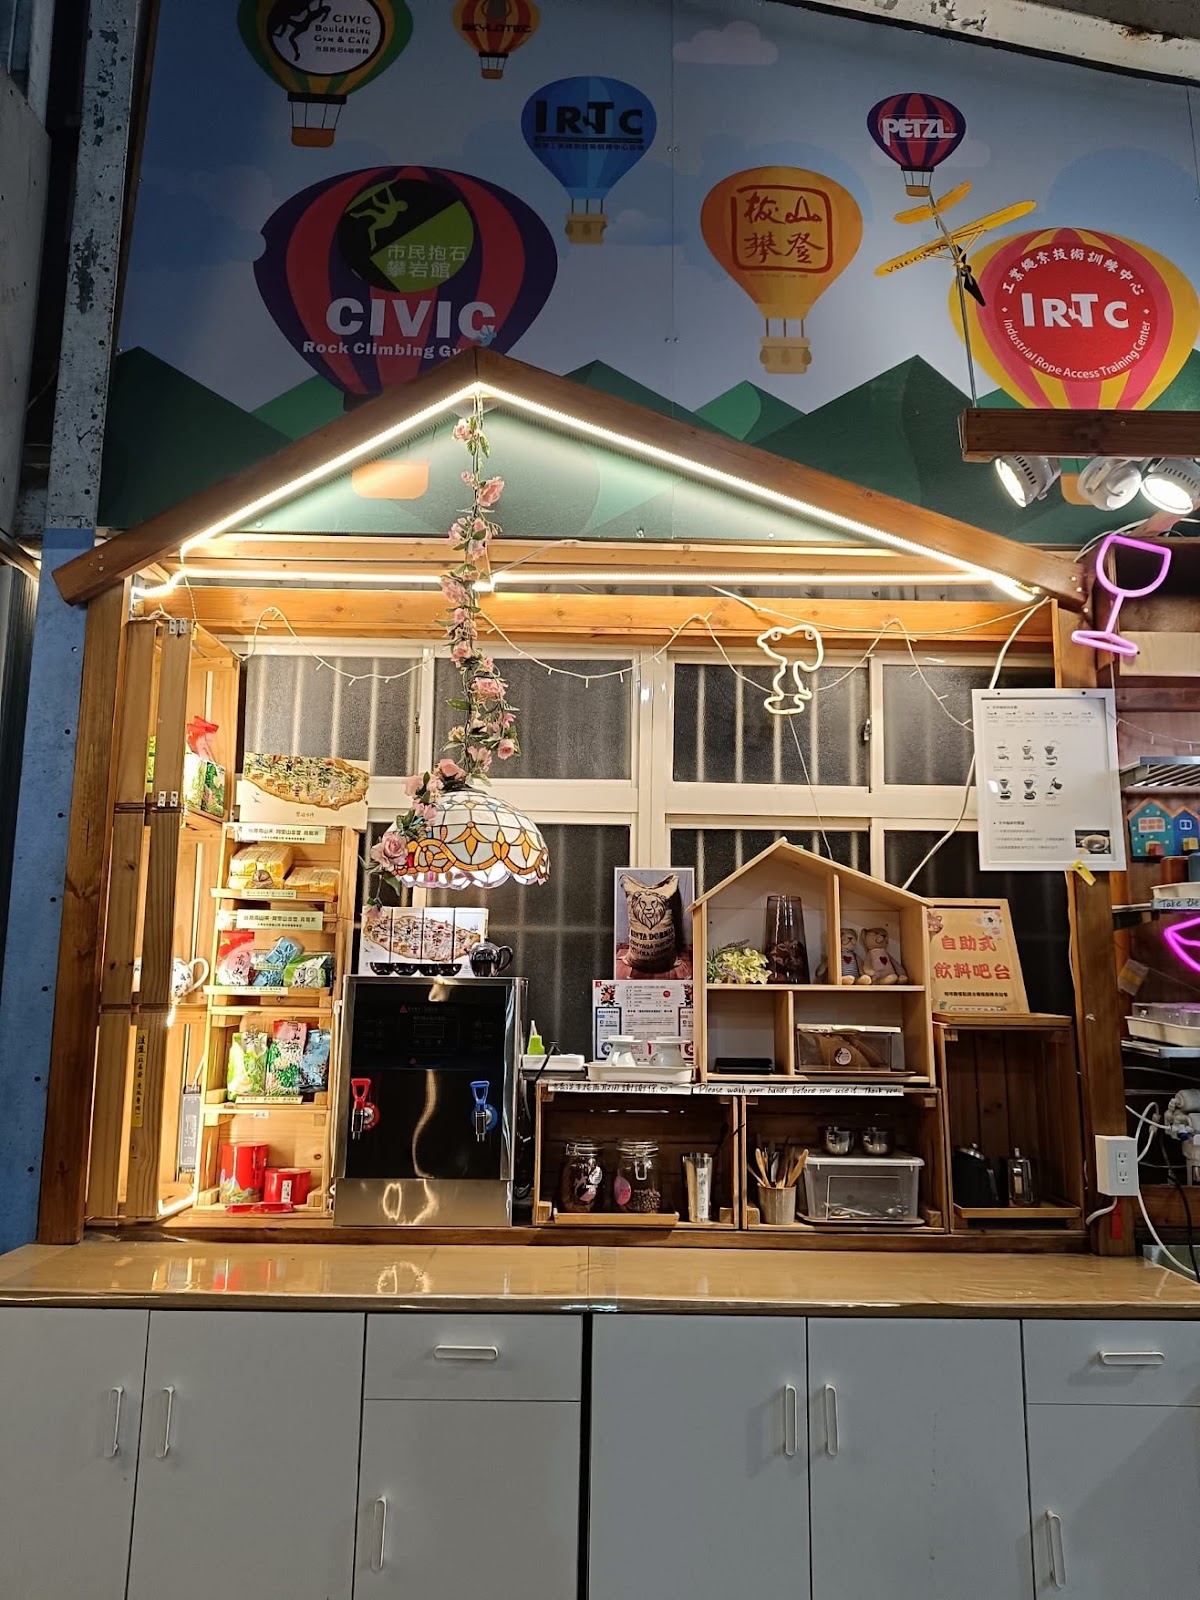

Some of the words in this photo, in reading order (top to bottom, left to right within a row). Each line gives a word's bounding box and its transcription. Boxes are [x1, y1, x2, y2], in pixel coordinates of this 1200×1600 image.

[333, 14, 372, 25] CIVIC
[461, 23, 532, 33] SKYLOTEC
[314, 35, 334, 43] Gym
[315, 24, 371, 36] Bouldering
[882, 118, 958, 147] PETZL
[388, 244, 467, 262] 市民抱石
[387, 261, 451, 279] 攀岩館
[326, 297, 496, 340] CIVIC
[1021, 293, 1129, 328] IRTC
[303, 340, 349, 354] Rock
[353, 342, 435, 359] Climbing
[1003, 318, 1036, 362] Industrial
[1035, 356, 1063, 376] Rope
[1063, 366, 1100, 379] Access
[1099, 345, 1140, 376] Training
[1133, 320, 1151, 352] Center
[1158, 899, 1182, 907] Take
[941, 934, 997, 952] 自助式
[933, 962, 1011, 980] 飲料吧台
[699, 1084, 723, 1094] Please
[727, 1085, 746, 1094] wash
[749, 1087, 764, 1095] your
[767, 1085, 787, 1094] hands
[792, 1085, 817, 1095] before
[819, 1087, 832, 1095] you
